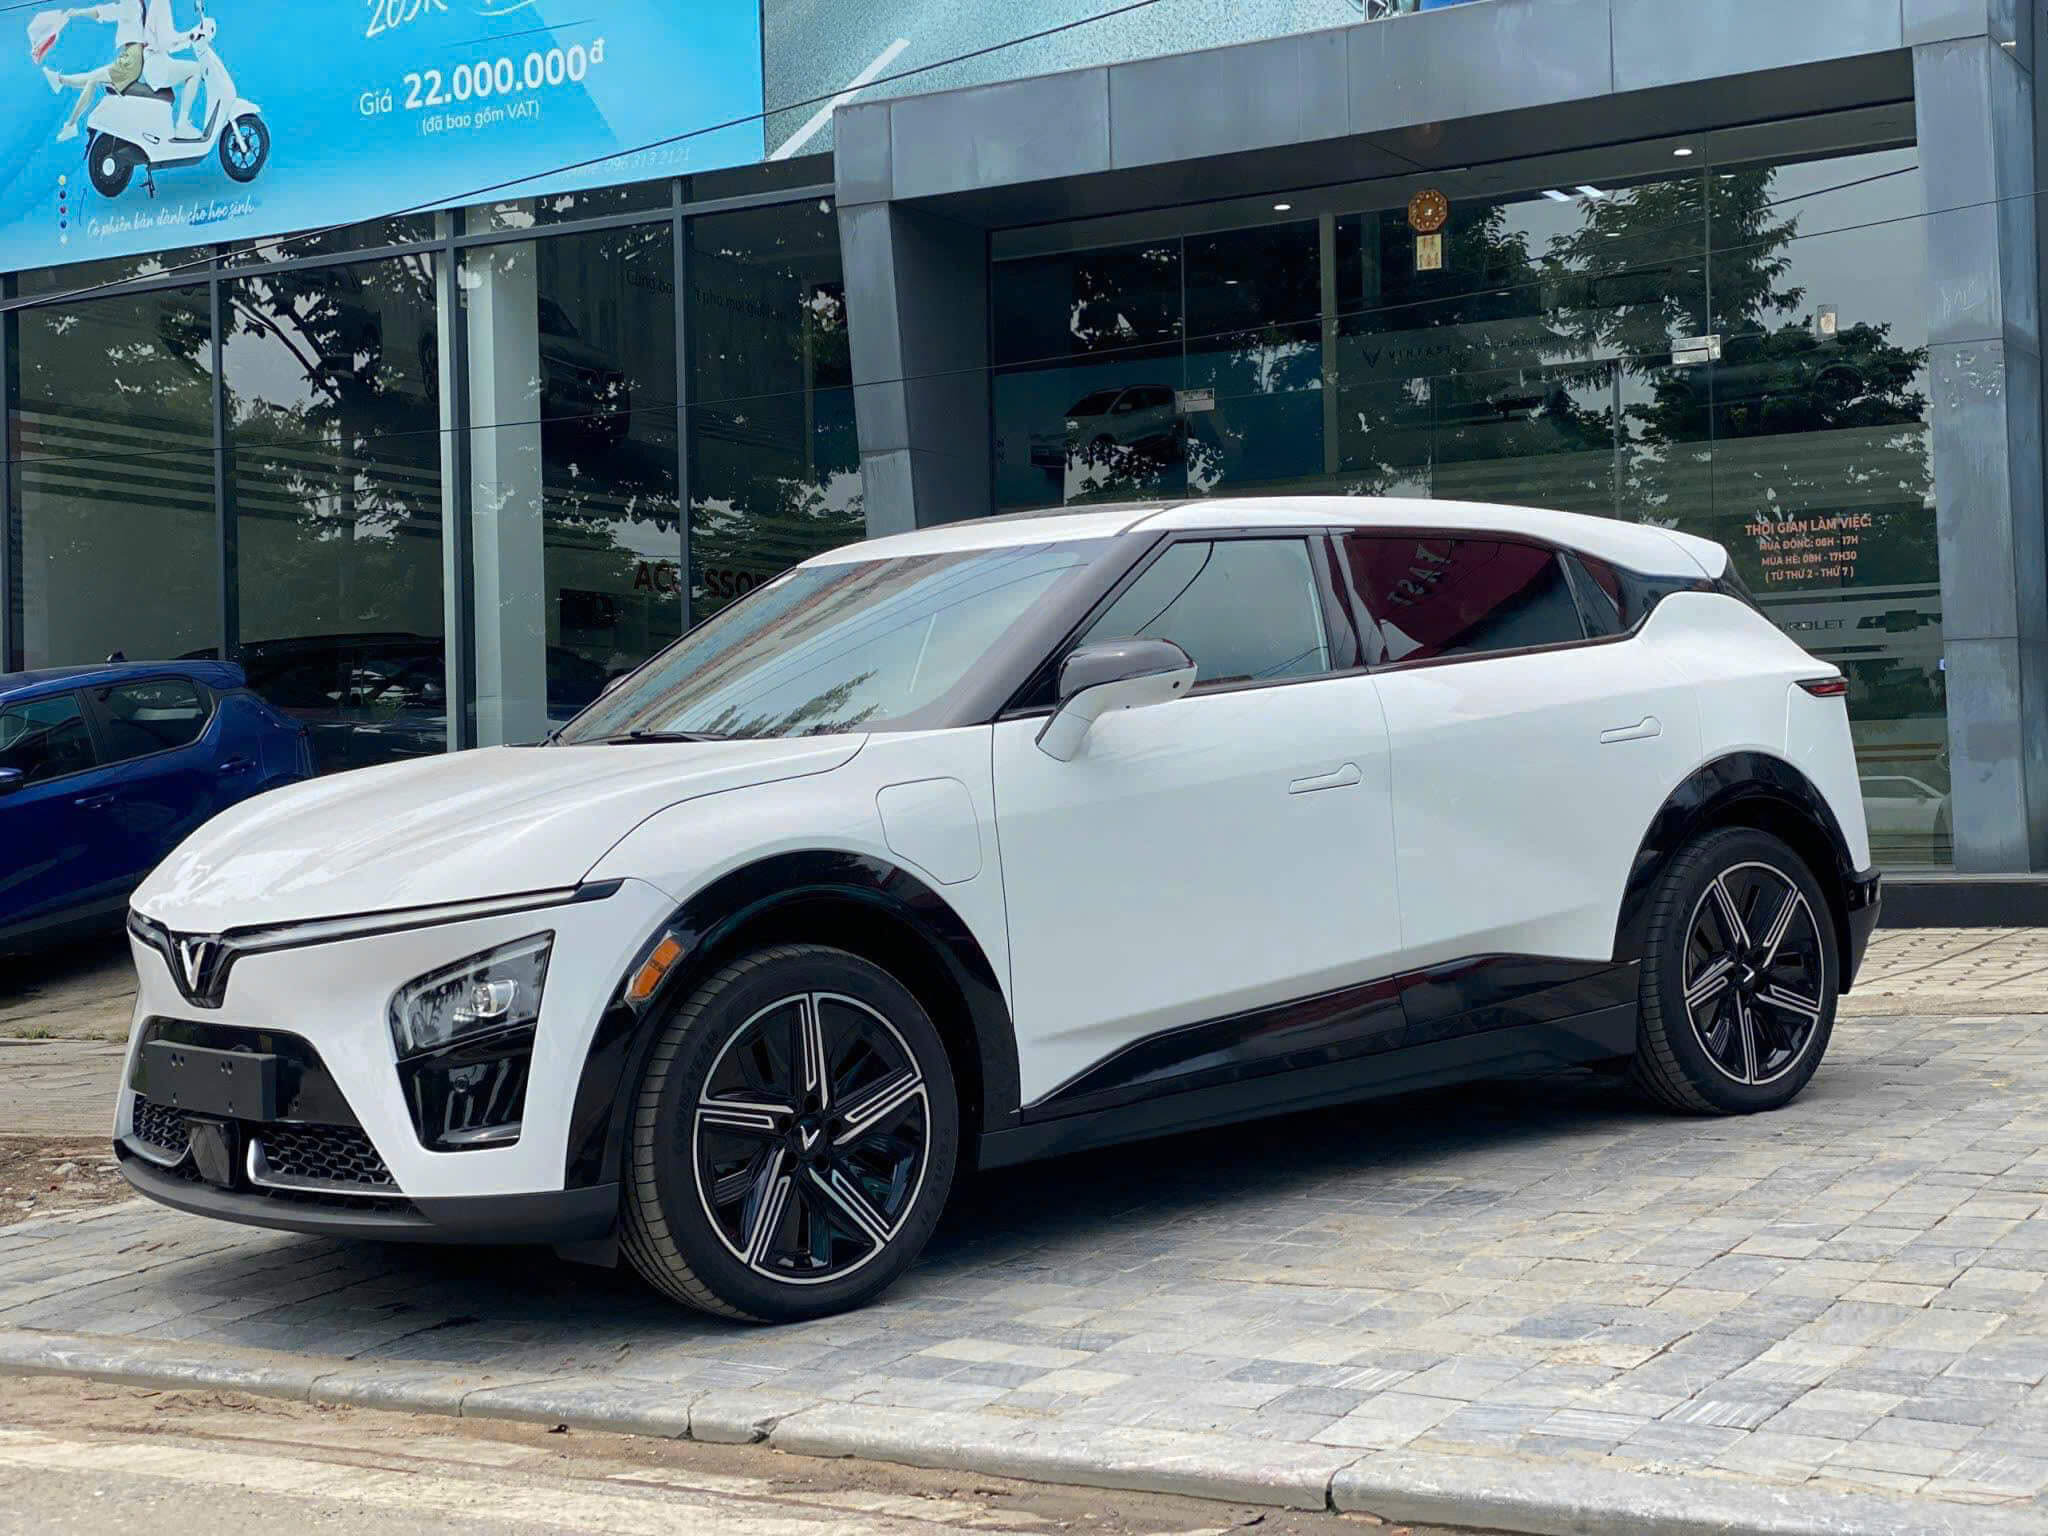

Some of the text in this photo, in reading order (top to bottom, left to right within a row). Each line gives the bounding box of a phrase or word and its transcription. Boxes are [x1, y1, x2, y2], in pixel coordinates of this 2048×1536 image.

[359, 88, 393, 116] Giá
[422, 99, 540, 136] (đã bao gồm VAT)
[1777, 520, 1808, 534] GIAN
[1810, 515, 1837, 531] LÀM
